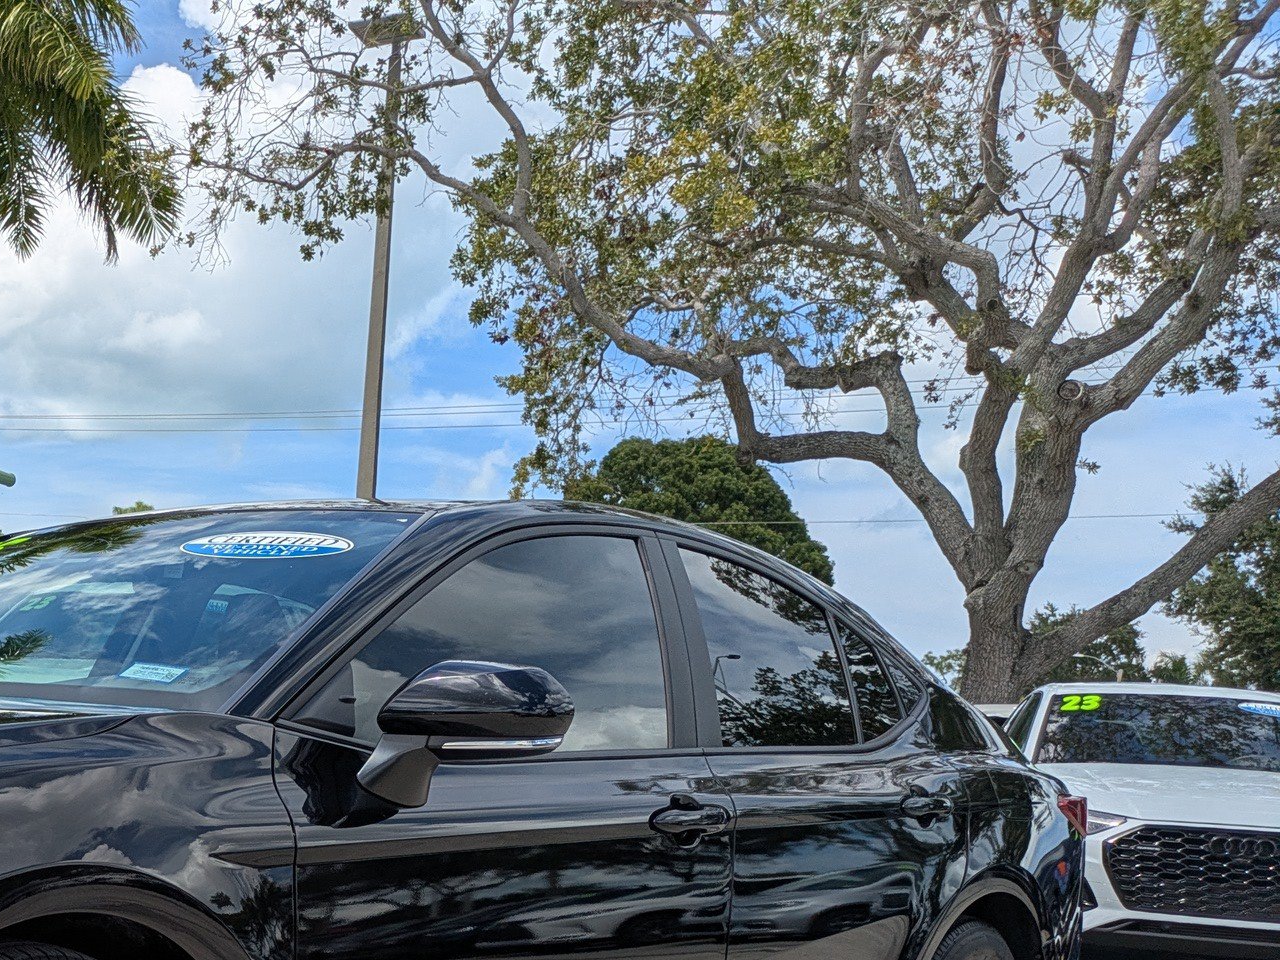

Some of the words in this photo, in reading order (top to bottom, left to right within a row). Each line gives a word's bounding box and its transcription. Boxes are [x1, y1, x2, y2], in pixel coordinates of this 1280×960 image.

[208, 535, 340, 545] CERTIFIED
[213, 548, 294, 556] VEHICLE
[1060, 695, 1102, 711] 23
